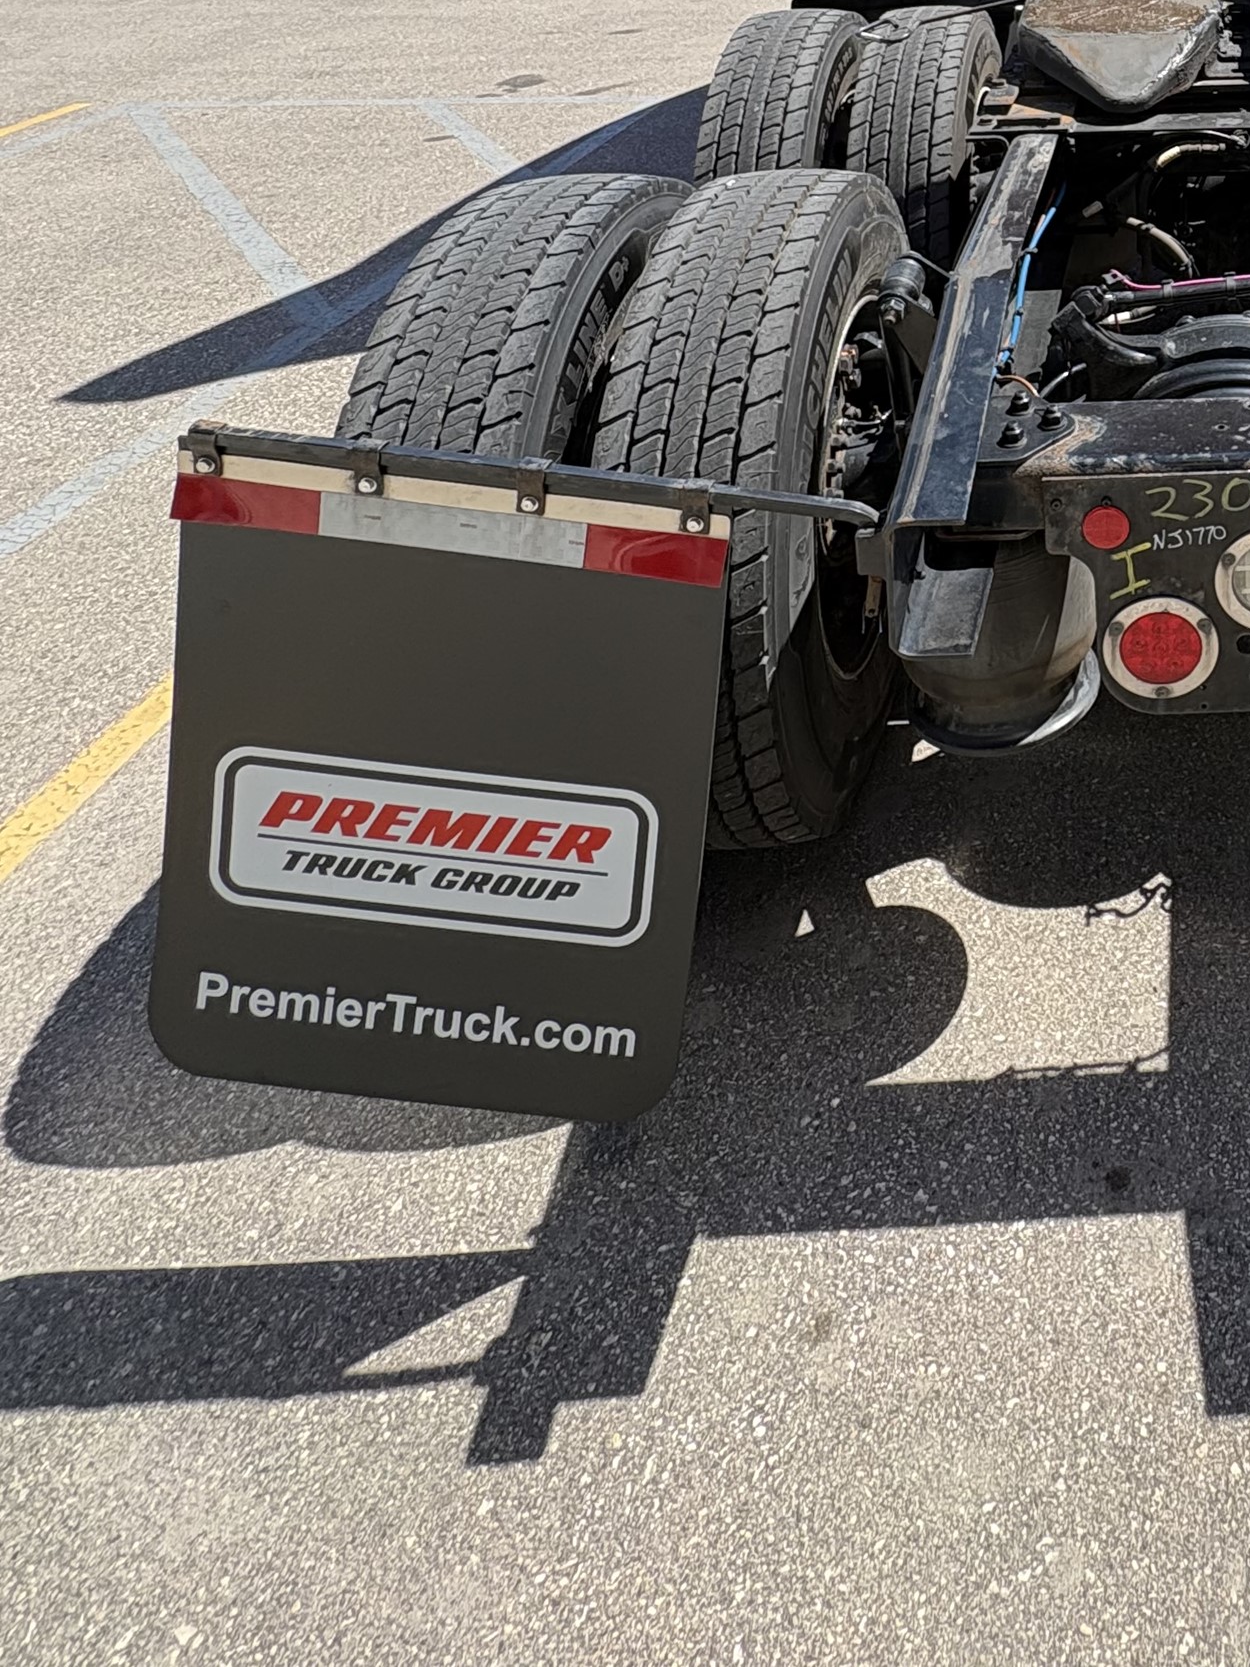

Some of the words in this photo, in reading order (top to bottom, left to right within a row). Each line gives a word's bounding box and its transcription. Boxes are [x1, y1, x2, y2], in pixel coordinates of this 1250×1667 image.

[257, 790, 612, 865] PREMIER
[282, 849, 428, 886] TRUCK
[431, 867, 581, 902] GROUP
[195, 970, 637, 1059] PremierTruck.com
